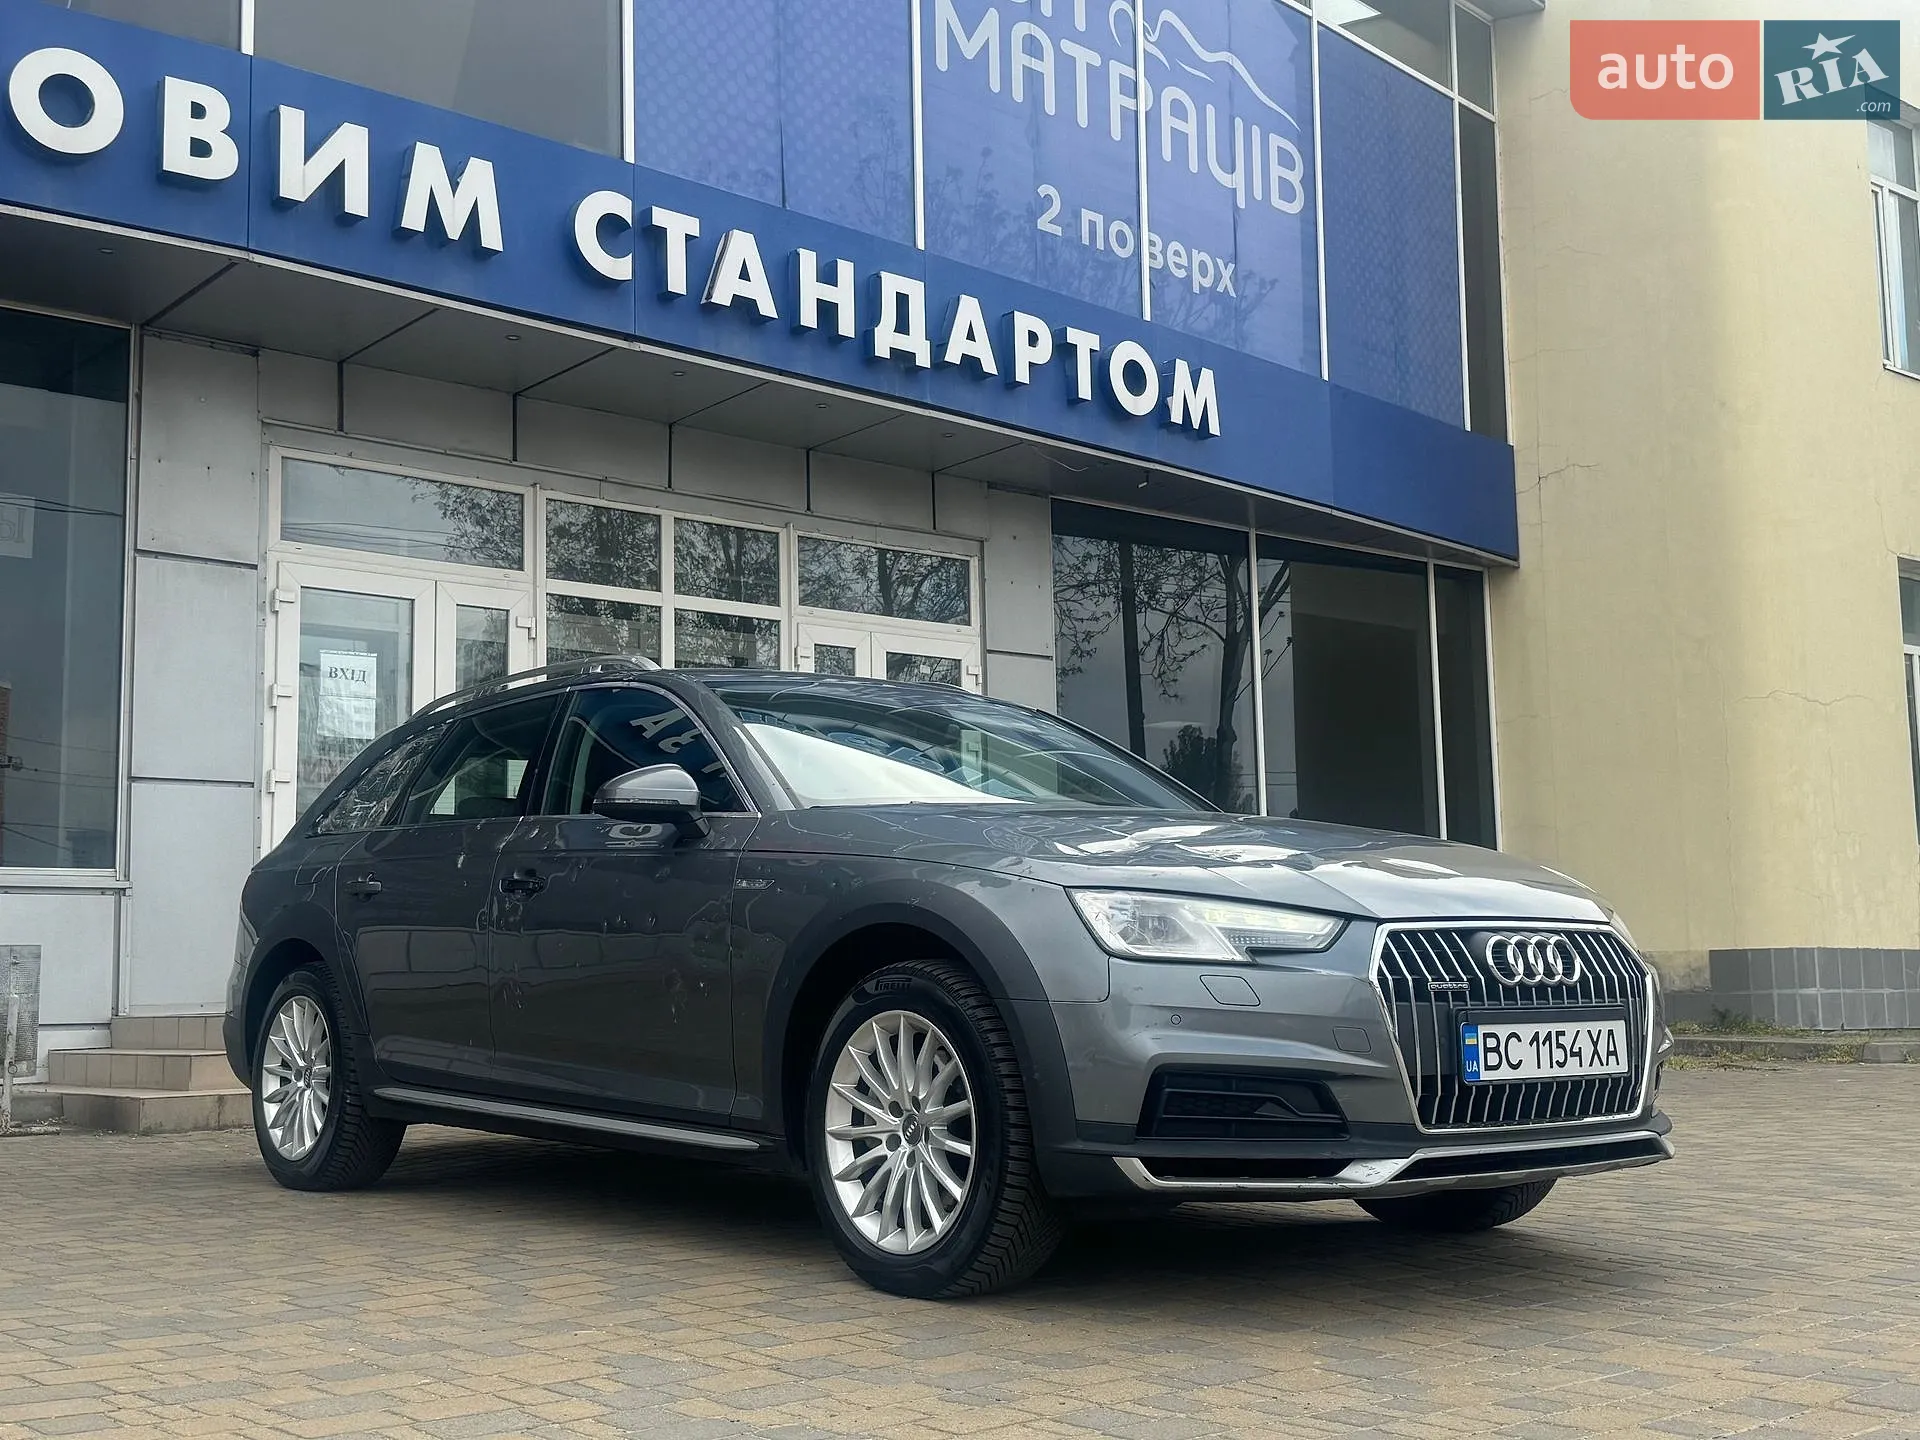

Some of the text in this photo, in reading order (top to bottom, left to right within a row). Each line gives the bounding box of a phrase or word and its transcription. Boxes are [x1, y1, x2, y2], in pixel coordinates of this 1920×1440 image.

[935, 0, 1304, 214] МАТРАЦІВ
[9, 47, 1222, 437] ОВИМ СТАНДАРТОМ
[1037, 184, 1236, 298] 2 поверх
[328, 666, 367, 684] ВХІД
[1466, 1061, 1479, 1072] UA
[1529, 1030, 1583, 1069] 1154
